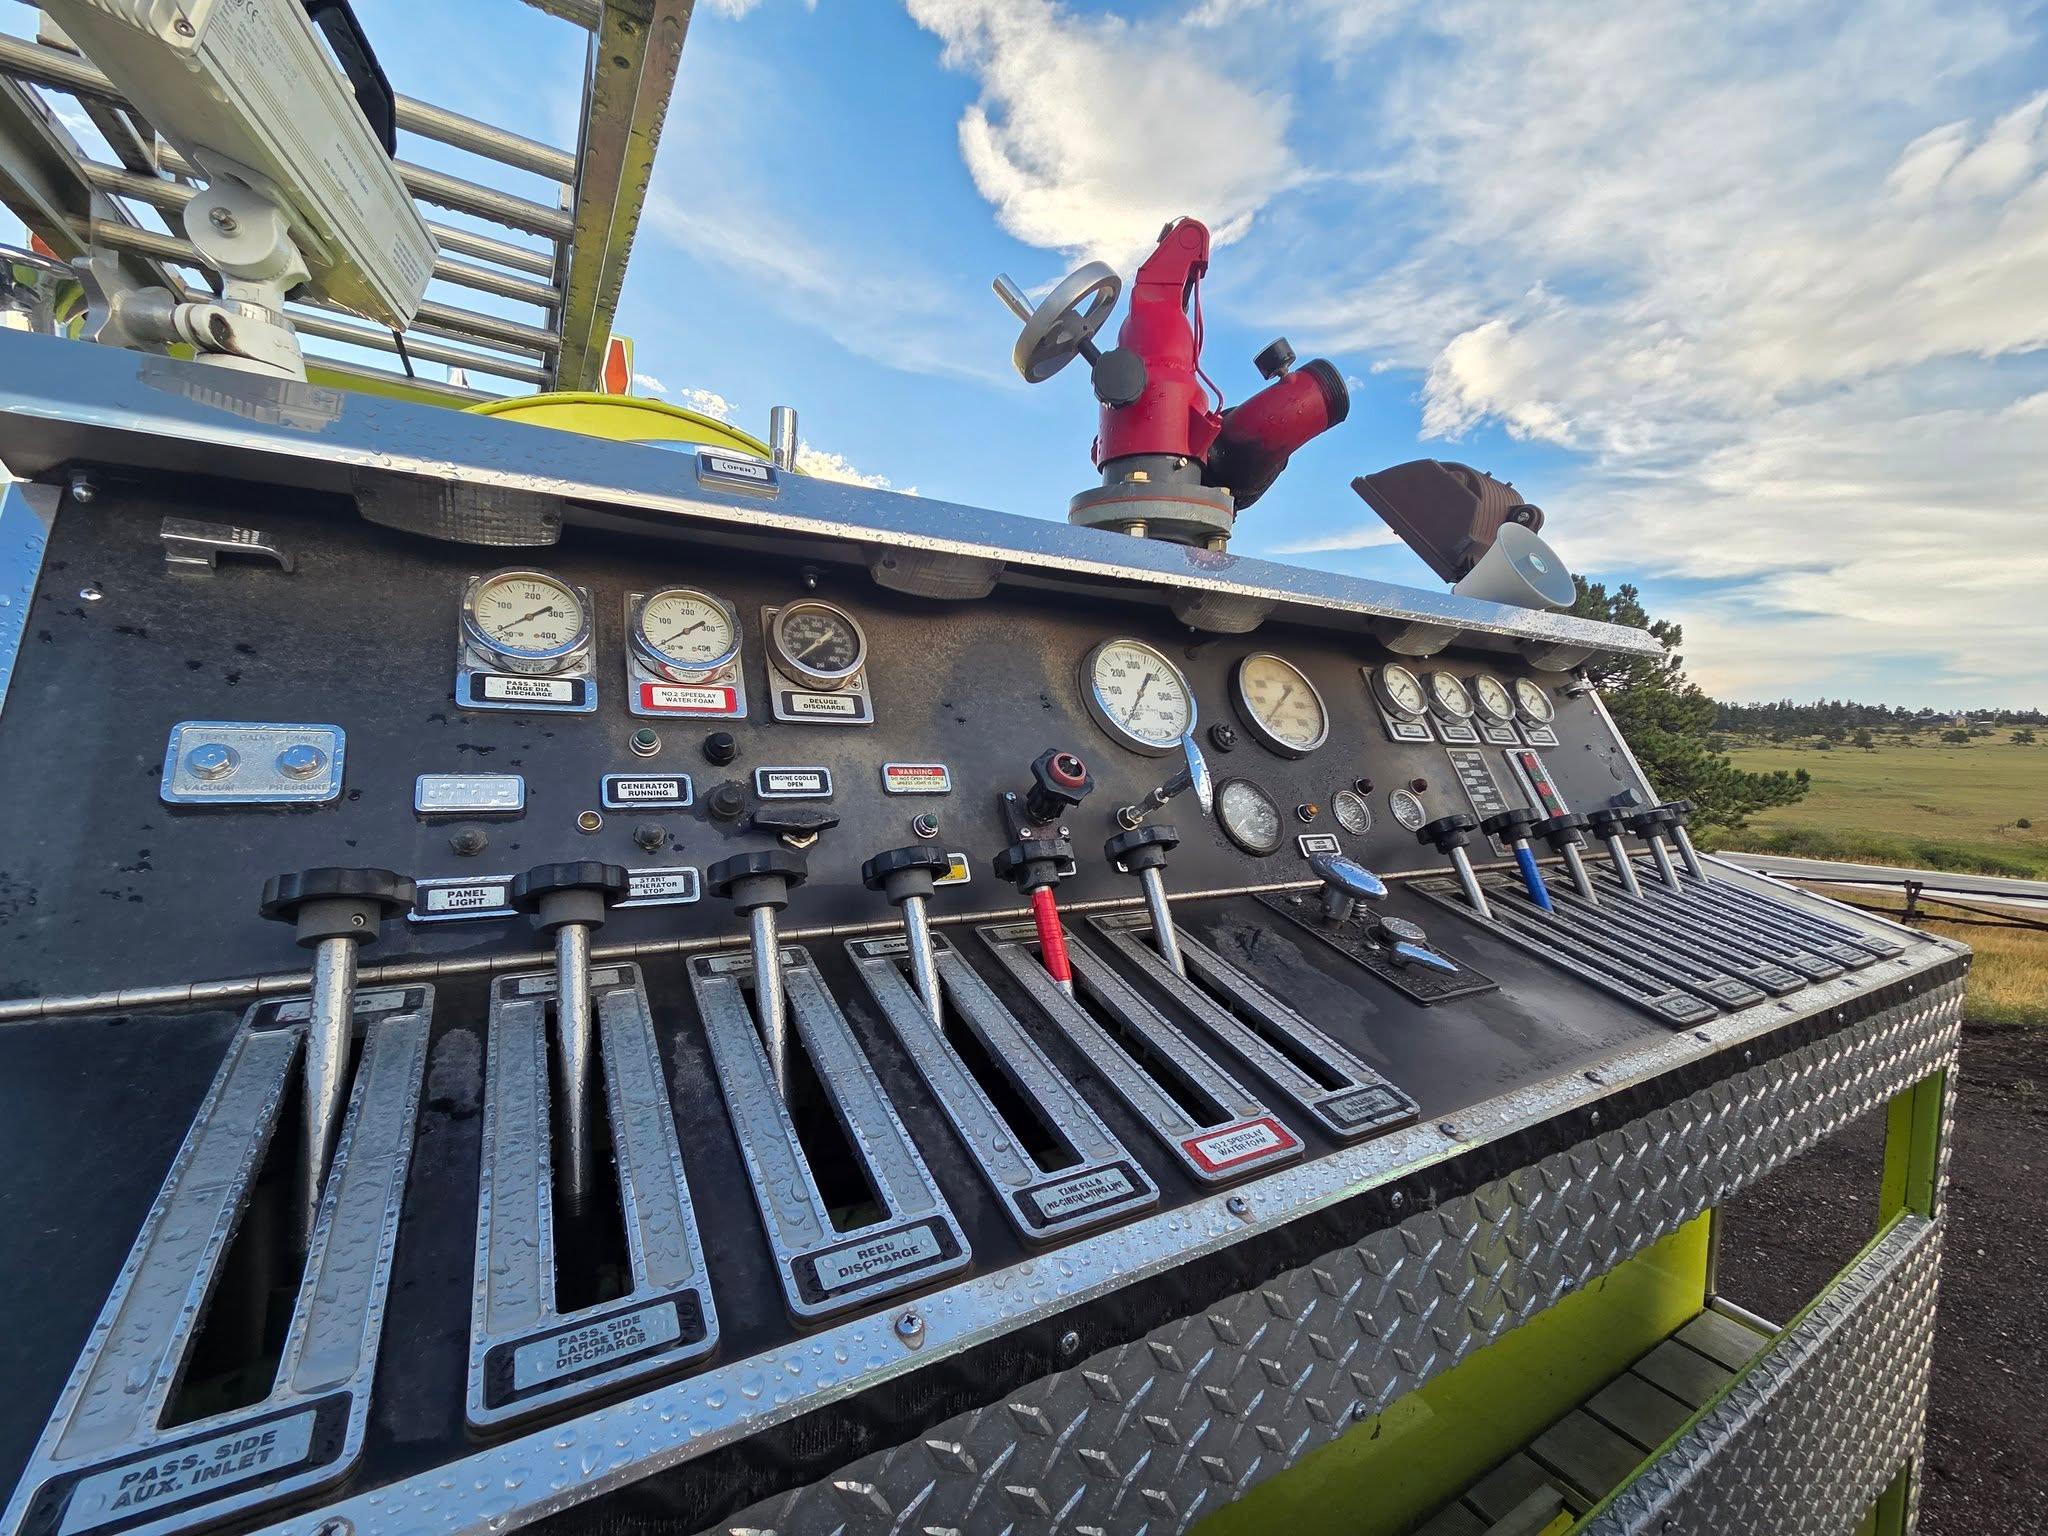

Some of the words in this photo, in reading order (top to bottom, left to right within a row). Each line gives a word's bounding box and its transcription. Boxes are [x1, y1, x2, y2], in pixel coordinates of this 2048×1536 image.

[524, 592, 541, 600] 200
[497, 601, 512, 609] 100
[548, 610, 564, 618] 300
[681, 608, 695, 616] 200
[659, 617, 672, 625] 100
[701, 625, 716, 633] 300
[1126, 660, 1140, 669] 300
[1110, 668, 1125, 677] 200
[505, 690, 553, 698] DISCHARGE
[1108, 686, 1122, 694] 100
[1157, 692, 1172, 701] 500
[804, 703, 846, 711] DISCHARGE
[1121, 707, 1127, 716] 0
[447, 889, 487, 898] PANEL
[449, 898, 485, 906] LIGHT
[1227, 1128, 1264, 1145] SPEEDLAY
[1058, 1185, 1080, 1196] TANK
[1079, 1179, 1096, 1190] FILL
[838, 1245, 920, 1278] DISCHARGE
[558, 1328, 603, 1348] PASS.
[607, 1315, 641, 1332] SIDE
[558, 1335, 609, 1358] LARGE
[613, 1326, 643, 1340] DIA.
[556, 1333, 646, 1369] DISCHARGE
[119, 1453, 206, 1491] PASS.
[214, 1429, 278, 1460] SIDE
[110, 1477, 183, 1511] AUX.
[191, 1447, 275, 1486] INLET
